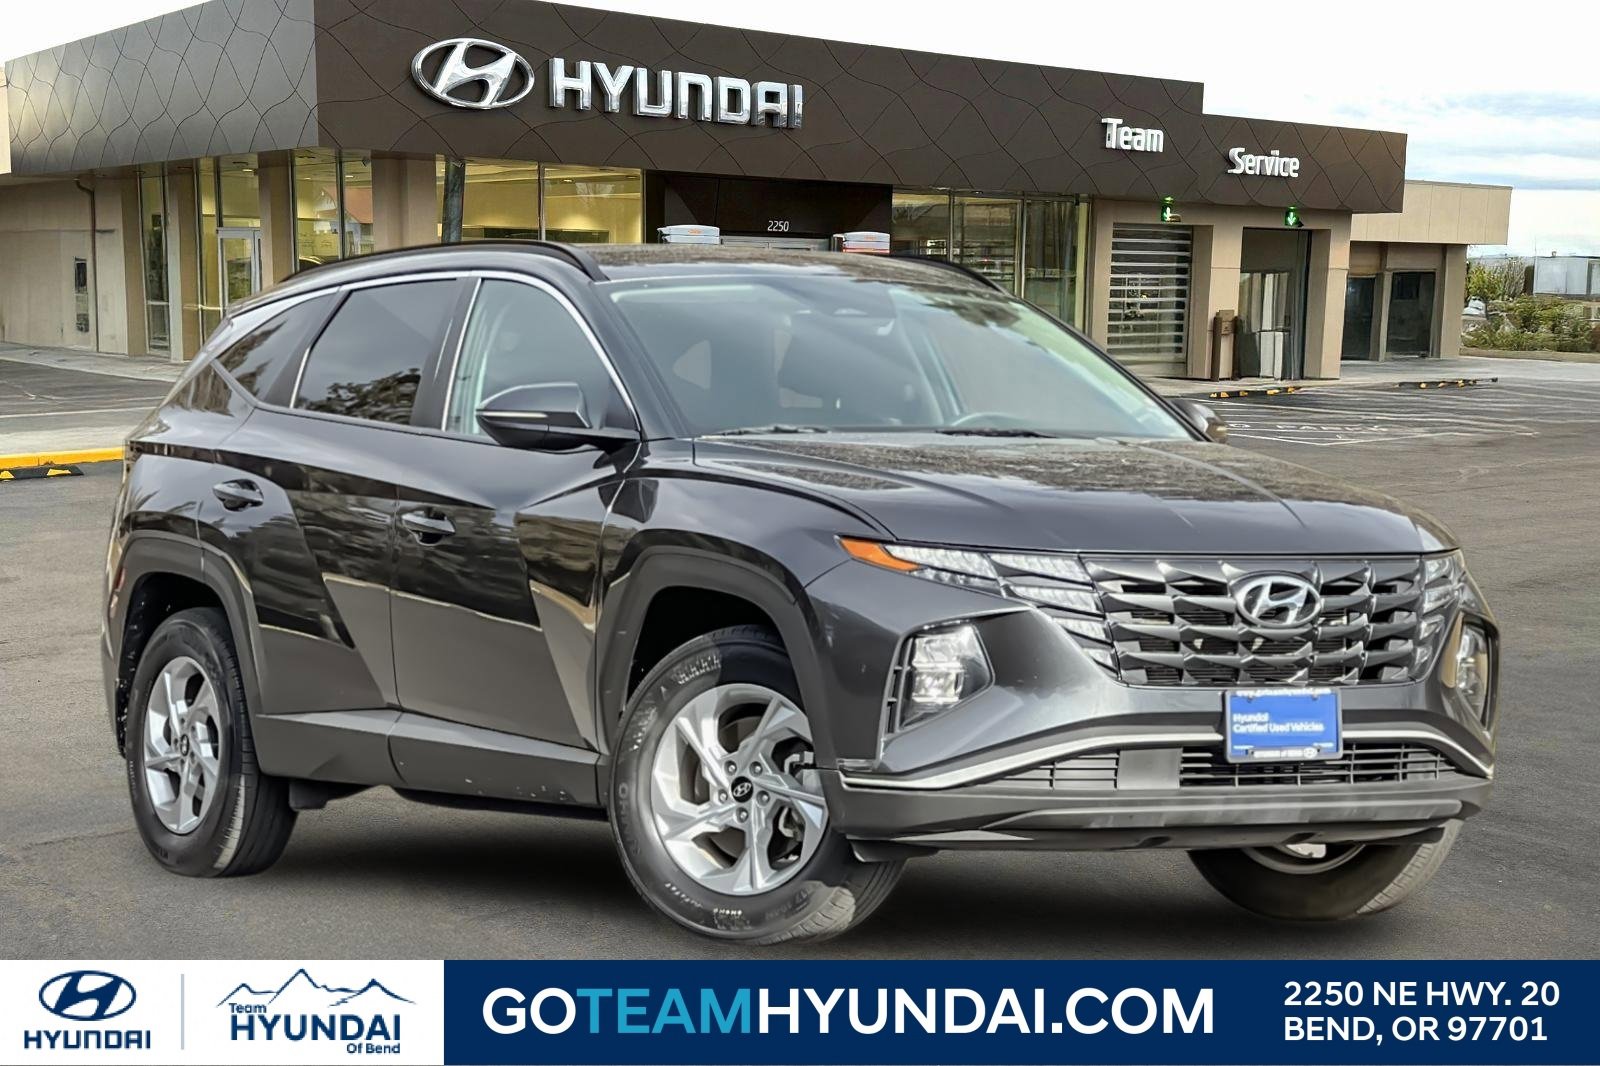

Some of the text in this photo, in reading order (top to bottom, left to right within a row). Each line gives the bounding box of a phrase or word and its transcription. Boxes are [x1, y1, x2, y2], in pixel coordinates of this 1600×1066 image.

[548, 57, 804, 129] HYUNDAI
[1101, 117, 1165, 152] Team
[1227, 147, 1300, 178] Service
[767, 220, 790, 232] 2250
[1233, 722, 1325, 733] Certified Used Vehicles
